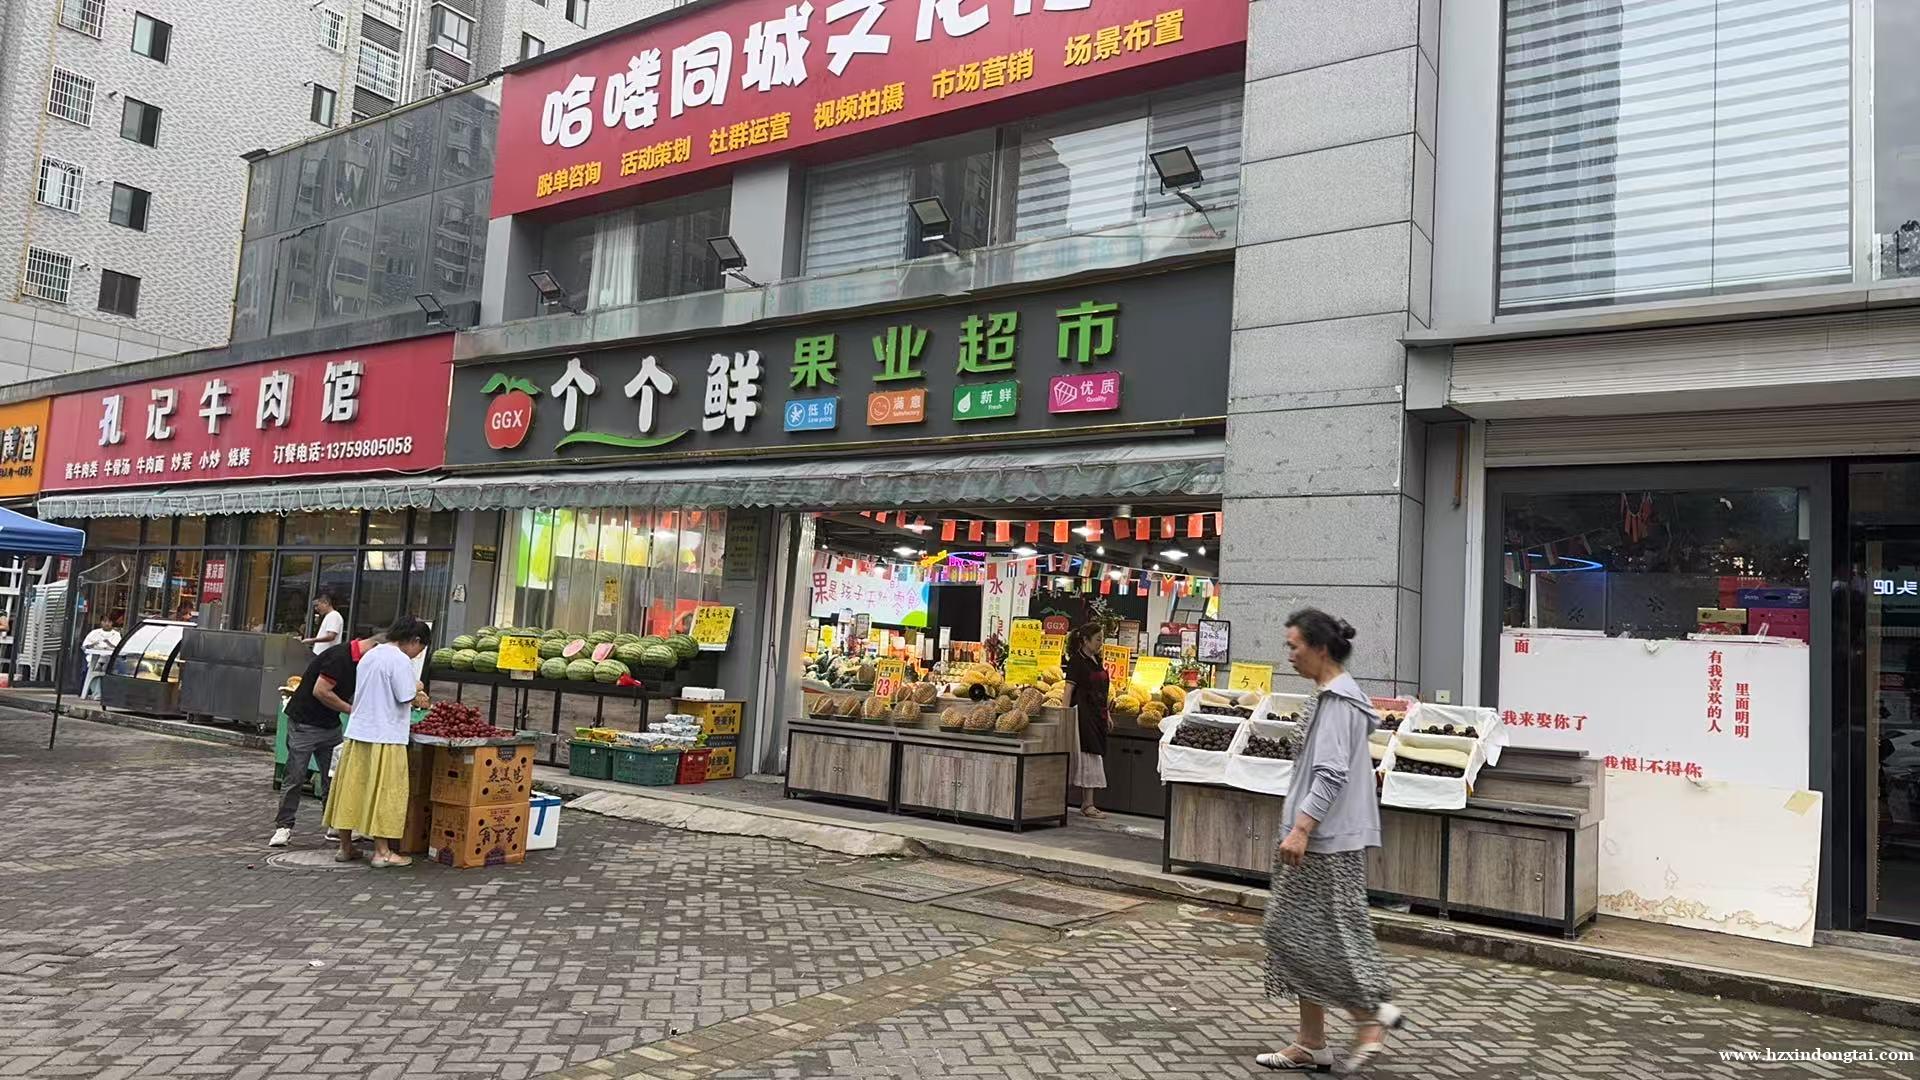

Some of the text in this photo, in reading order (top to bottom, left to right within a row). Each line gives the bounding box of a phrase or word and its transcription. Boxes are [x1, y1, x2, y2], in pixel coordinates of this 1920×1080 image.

[536, 8, 1184, 198] 脱单咨询 活动策划 社群运营 视频拍摄 市场营销 场景布置
[980, 388, 1012, 405] 新鲜
[1080, 379, 1115, 396] 优质
[98, 360, 367, 446] 孔记牛肉馆
[808, 403, 834, 416] 低价
[893, 395, 921, 410] 满意
[491, 409, 523, 430] GGX
[104, 457, 131, 477] 牛骨汤
[136, 455, 166, 474] 牛肉面
[171, 452, 194, 472] 炒菜
[199, 449, 222, 470] 小炒
[228, 447, 251, 467] 烧烤
[1046, 622, 1065, 630] GGX
[1707, 650, 1723, 733] 有我喜欢的人
[1502, 710, 1588, 731] 我来娶你了
[1735, 683, 1750, 738] 里面明明
